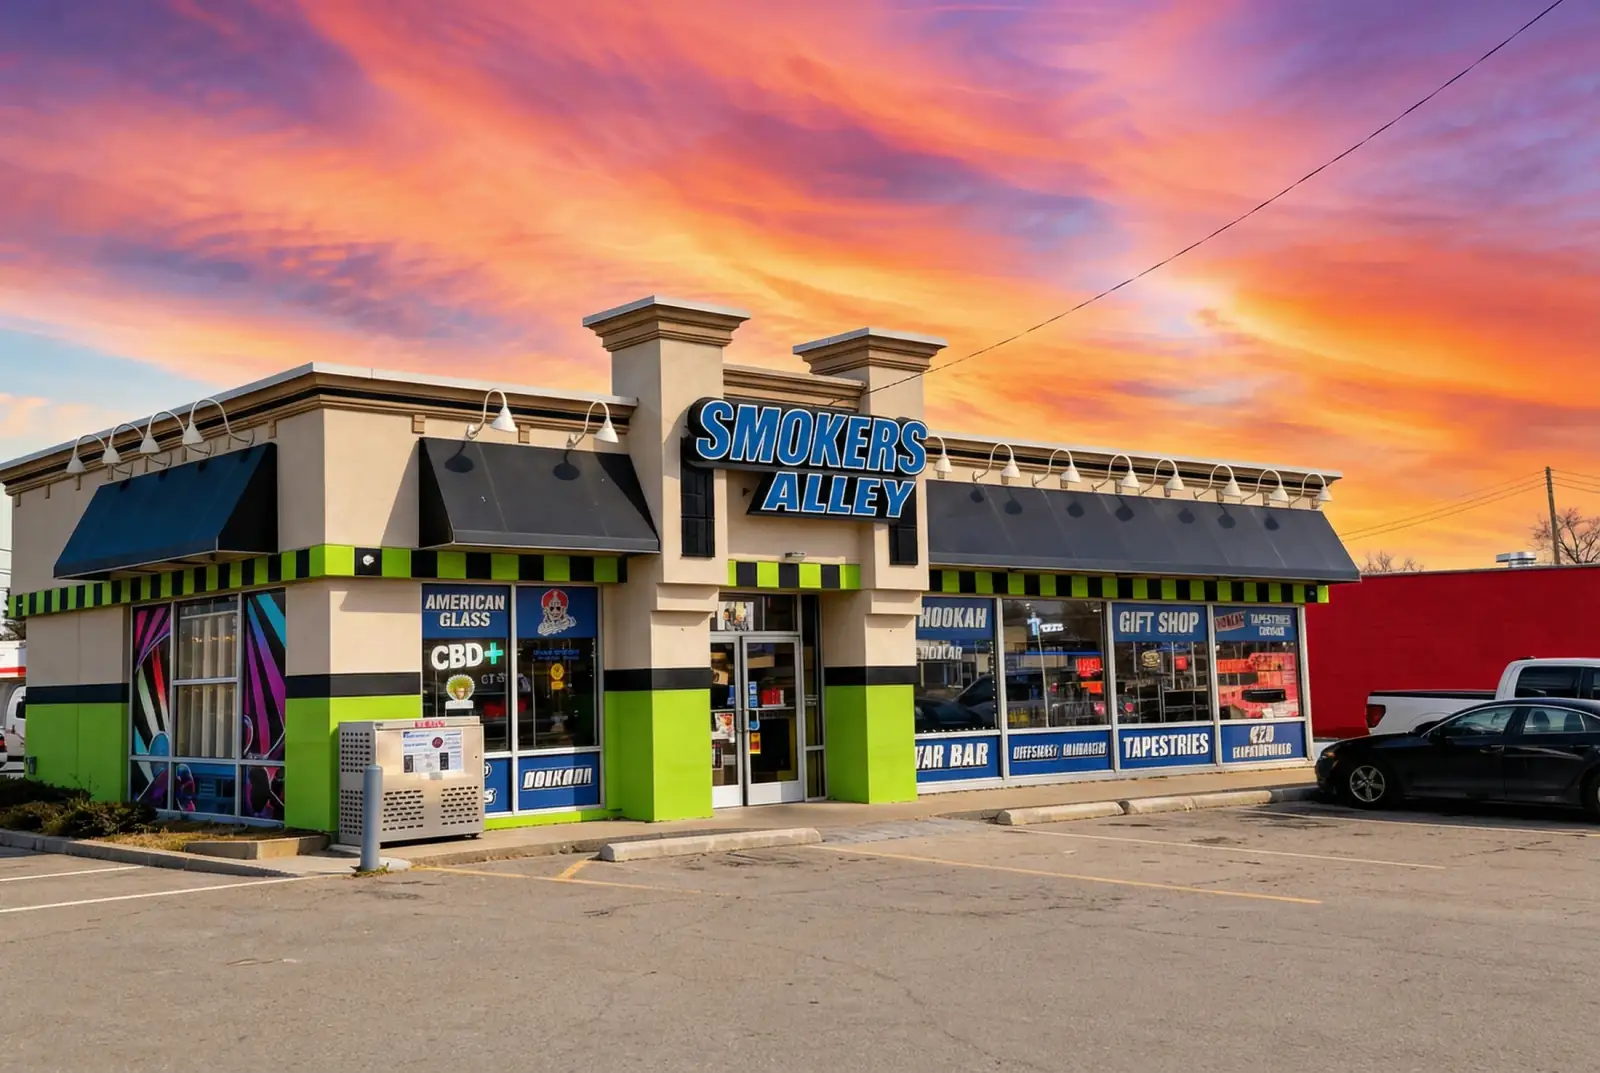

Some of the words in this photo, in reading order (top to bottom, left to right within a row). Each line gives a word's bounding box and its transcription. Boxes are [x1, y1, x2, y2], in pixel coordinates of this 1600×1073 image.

[696, 400, 928, 476] SMOKERS
[761, 472, 916, 518] ALLEY
[425, 594, 505, 610] AMERICAN
[439, 611, 491, 628] GLASS
[919, 606, 987, 628] HOOKAH
[1119, 611, 1154, 633] GIFT
[1158, 612, 1199, 634] SHOP
[950, 742, 989, 767] BAR
[1123, 733, 1209, 758] TAPESTRIES
